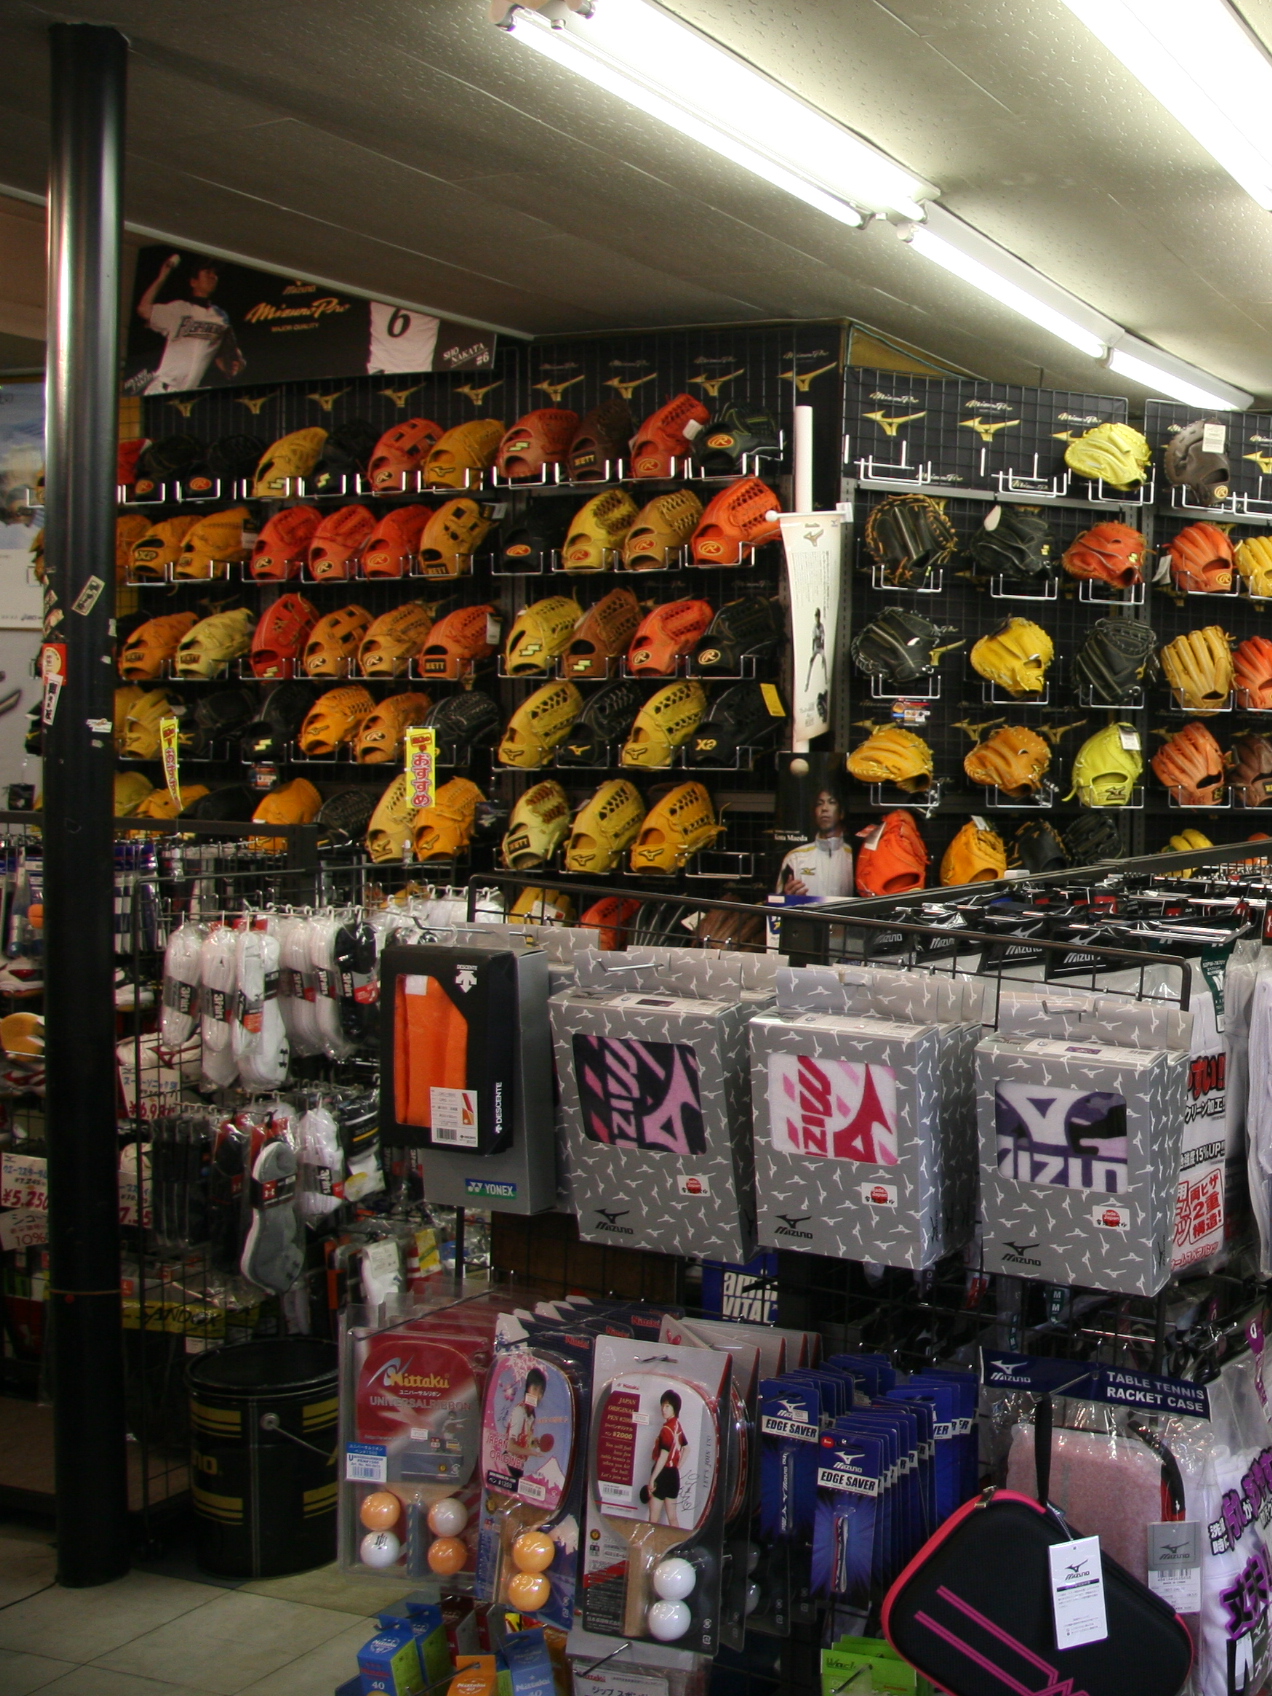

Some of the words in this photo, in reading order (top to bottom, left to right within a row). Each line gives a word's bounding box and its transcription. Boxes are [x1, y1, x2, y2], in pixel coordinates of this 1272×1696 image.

[387, 307, 411, 338] 6
[443, 347, 460, 360] SHO
[451, 342, 486, 365] NAKATA
[476, 352, 490, 366] #6
[411, 753, 432, 807] おすすめ
[484, 1183, 514, 1197] YONEX
[1193, 1190, 1221, 1218] 2重
[723, 1299, 771, 1323] VITAL
[390, 1372, 450, 1388] Nittaku
[1108, 1372, 1152, 1390] TABLE
[1154, 1380, 1205, 1400] TENNIS
[1107, 1387, 1163, 1405] RACKET
[1167, 1397, 1204, 1412] CASE
[766, 1418, 788, 1432] EDGE
[789, 1423, 817, 1438] SAVER
[821, 1471, 844, 1485] EDGE
[846, 1476, 876, 1491] SAVER
[372, 1681, 385, 1690] 40
